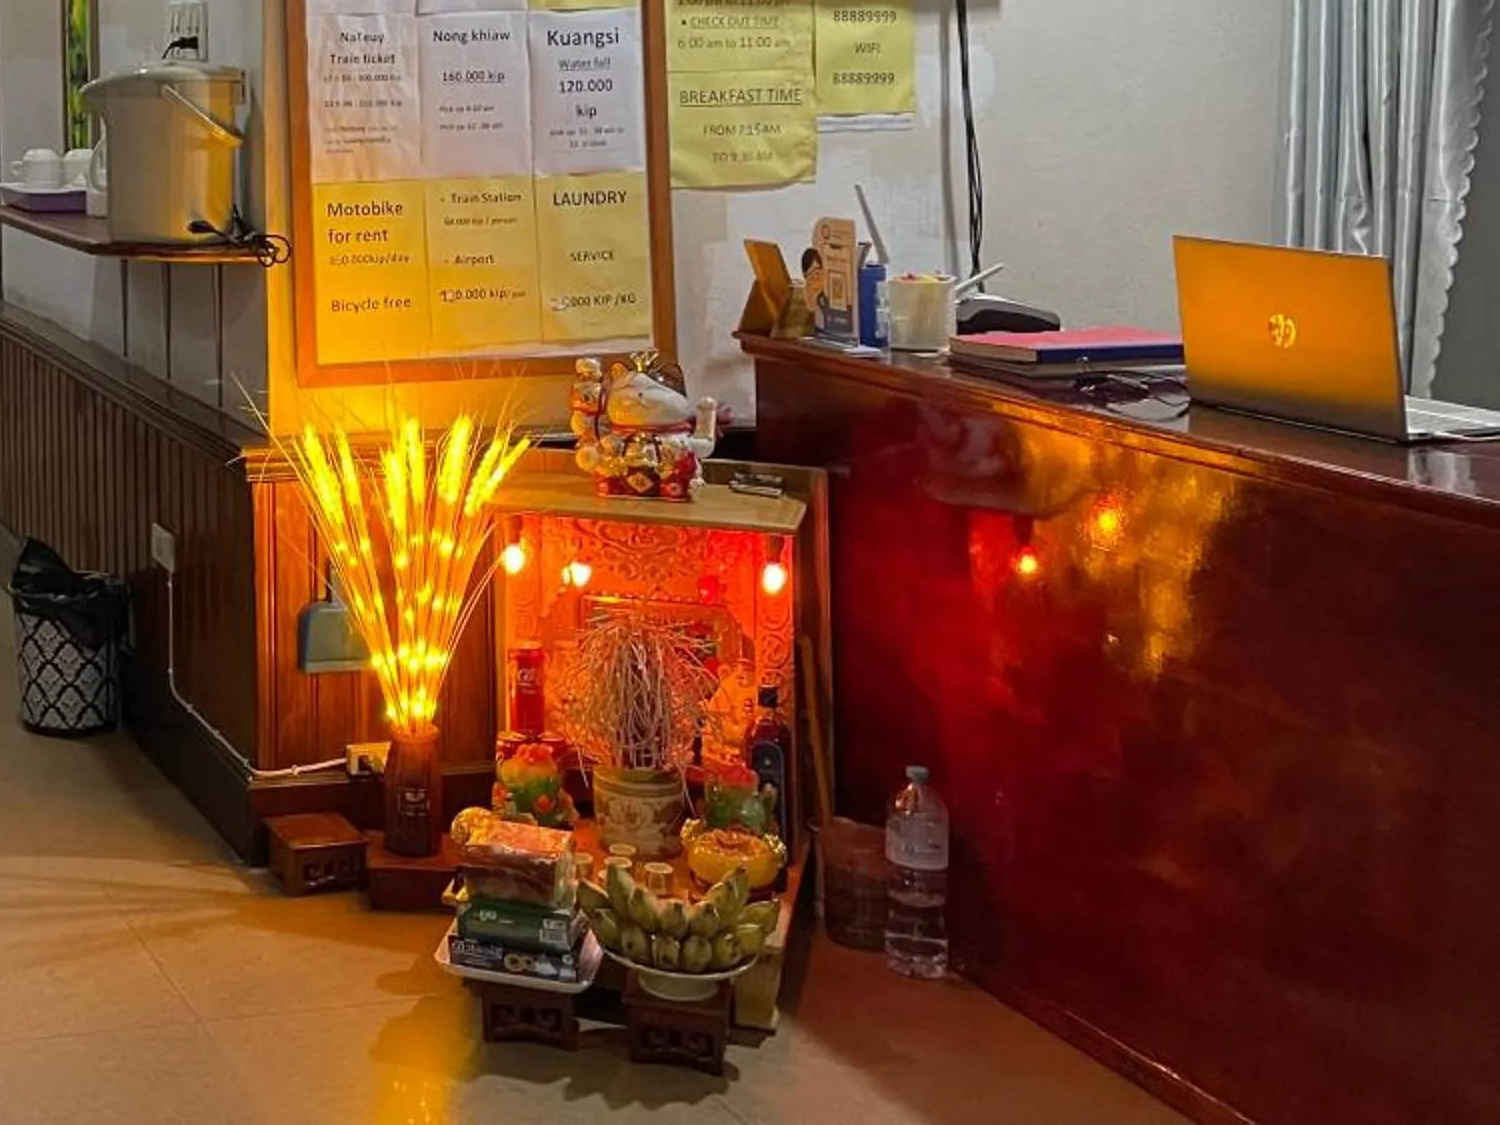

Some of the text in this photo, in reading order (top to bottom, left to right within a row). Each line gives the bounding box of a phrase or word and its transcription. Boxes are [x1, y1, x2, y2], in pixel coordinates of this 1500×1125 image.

[833, 10, 898, 24] 88889999
[433, 27, 510, 45] Nong khiaw
[547, 27, 619, 49] Kuangsi
[706, 39, 723, 49] am
[725, 36, 737, 49] to
[330, 54, 360, 64] Train
[559, 78, 613, 94] 120.000
[679, 87, 802, 105] BREAKFAST TIME
[576, 103, 597, 119] kip
[451, 192, 522, 204] Train Station
[552, 190, 627, 206] LAUNDRY
[326, 200, 404, 217] Motobike
[327, 228, 389, 244] for rent
[453, 254, 497, 267] Airport
[569, 250, 615, 262] SERVICE
[330, 295, 412, 313] Bicycle free
